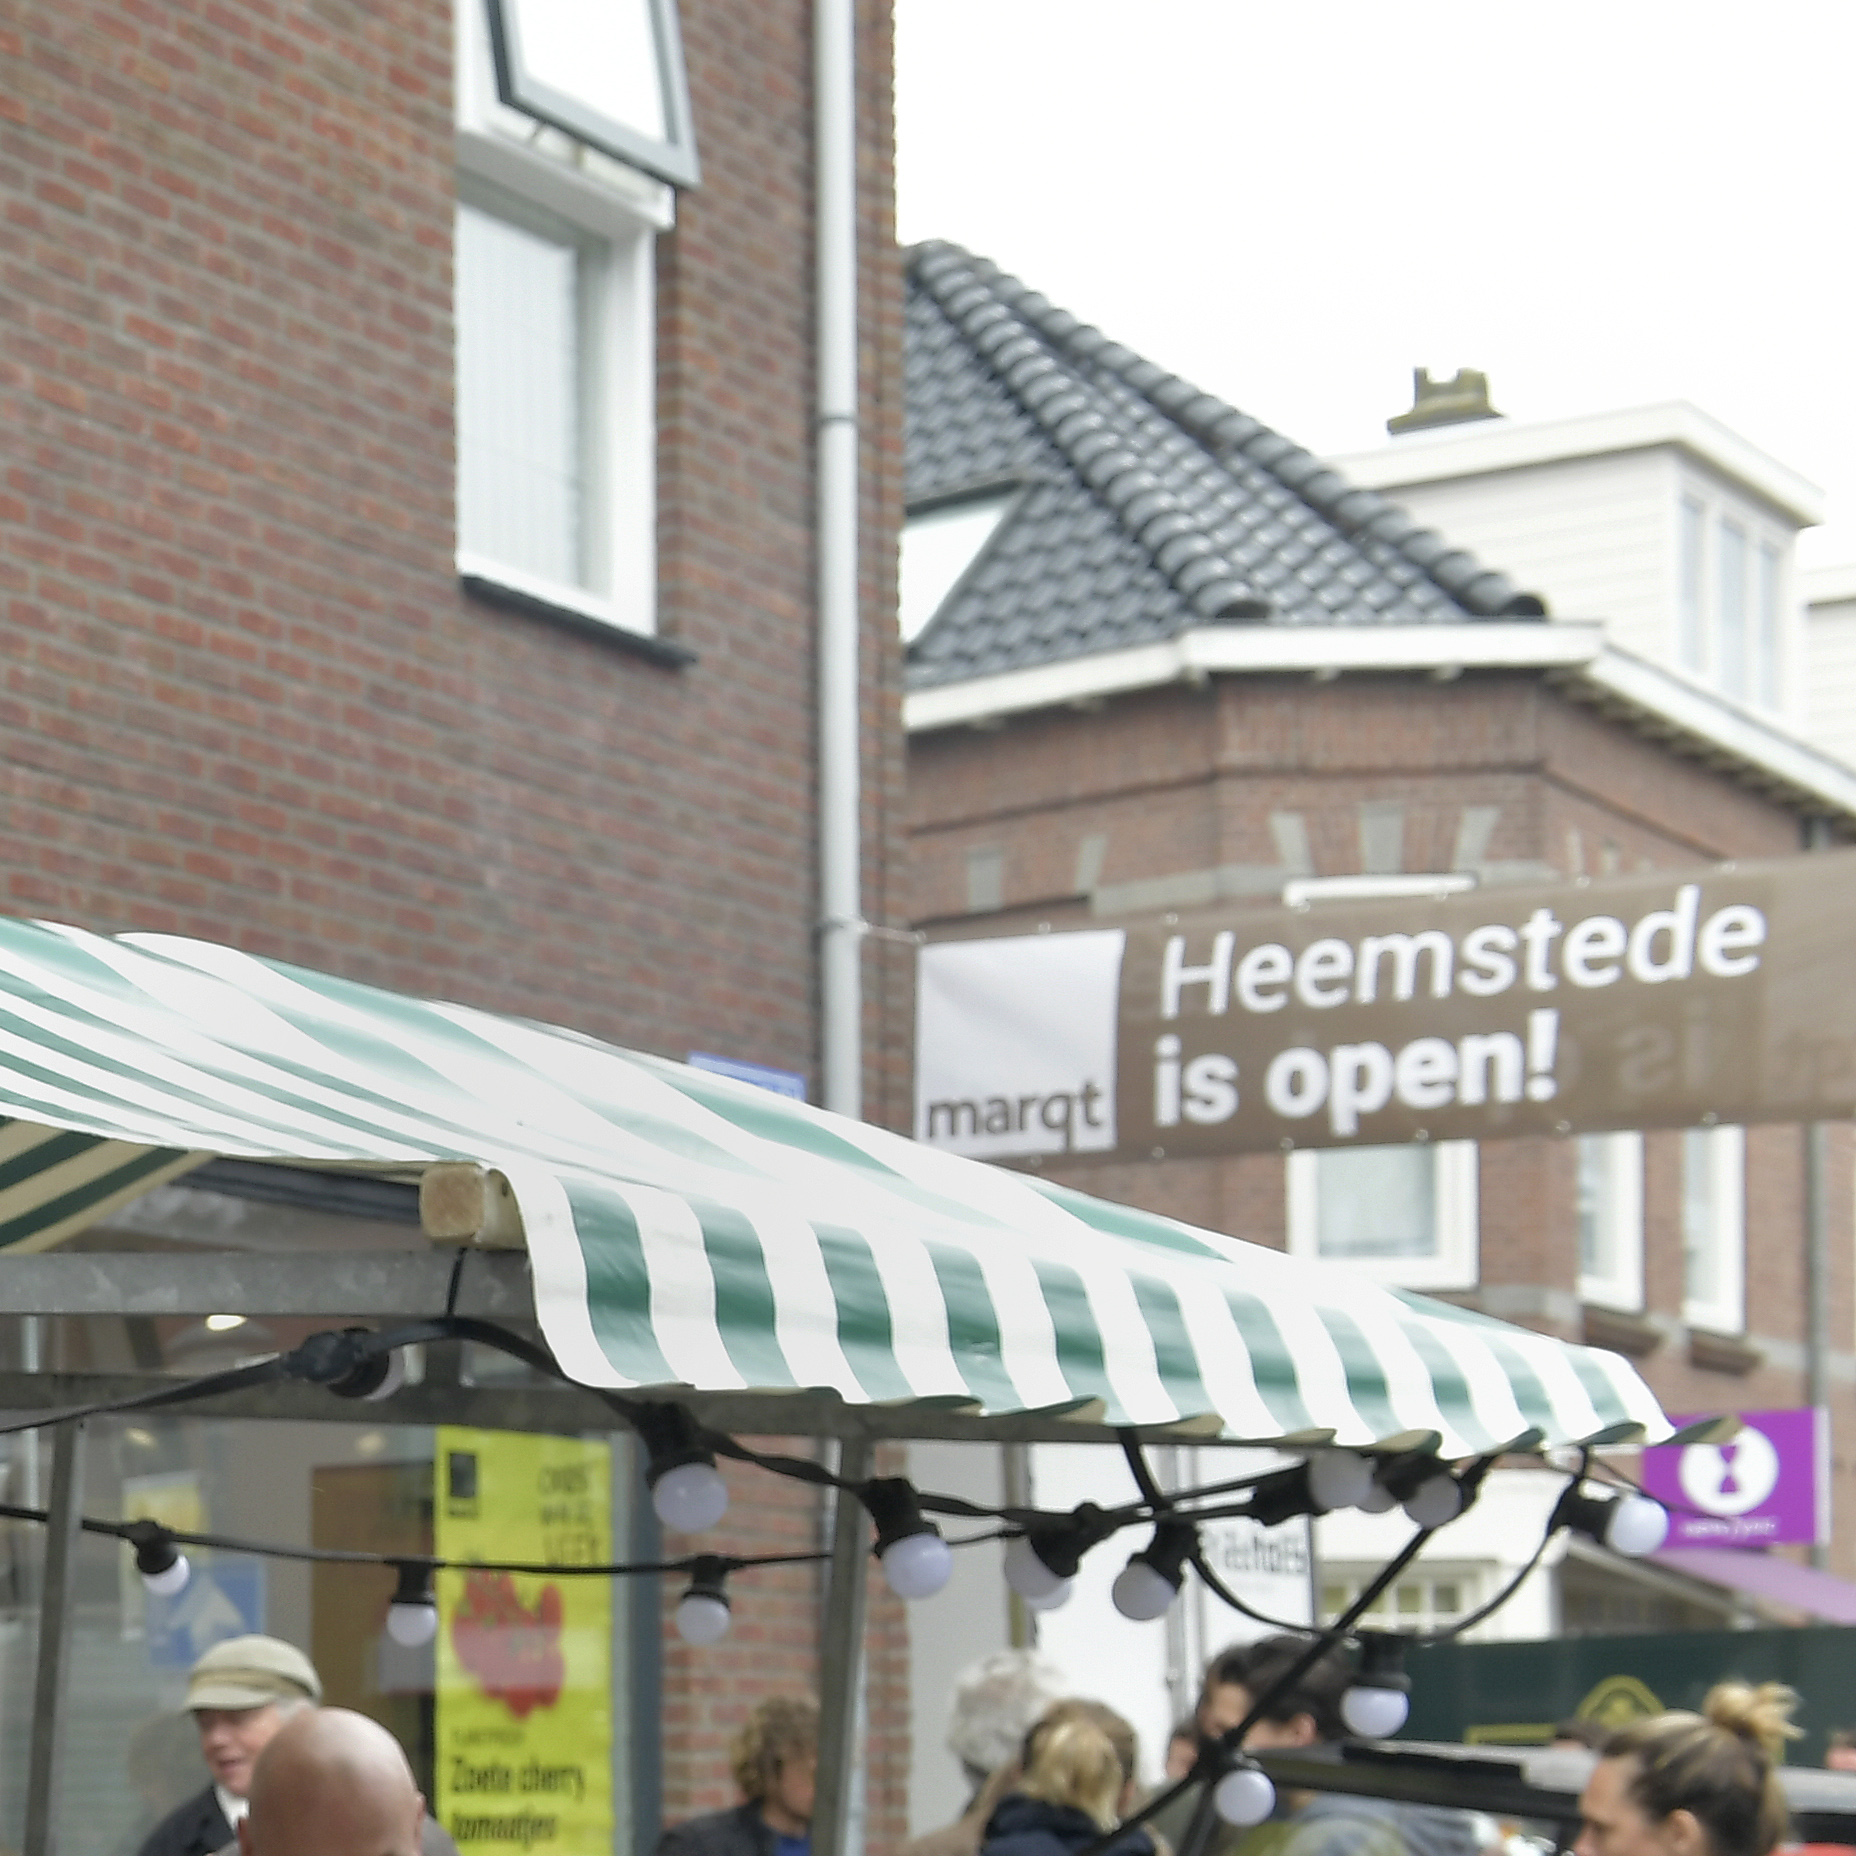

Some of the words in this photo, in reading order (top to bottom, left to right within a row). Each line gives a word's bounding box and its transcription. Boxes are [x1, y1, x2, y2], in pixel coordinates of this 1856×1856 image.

[1159, 884, 1768, 1020] Heemstede
[928, 1082, 1102, 1152] marqt
[1153, 1036, 1239, 1127] is
[1265, 1006, 1561, 1137] open!
